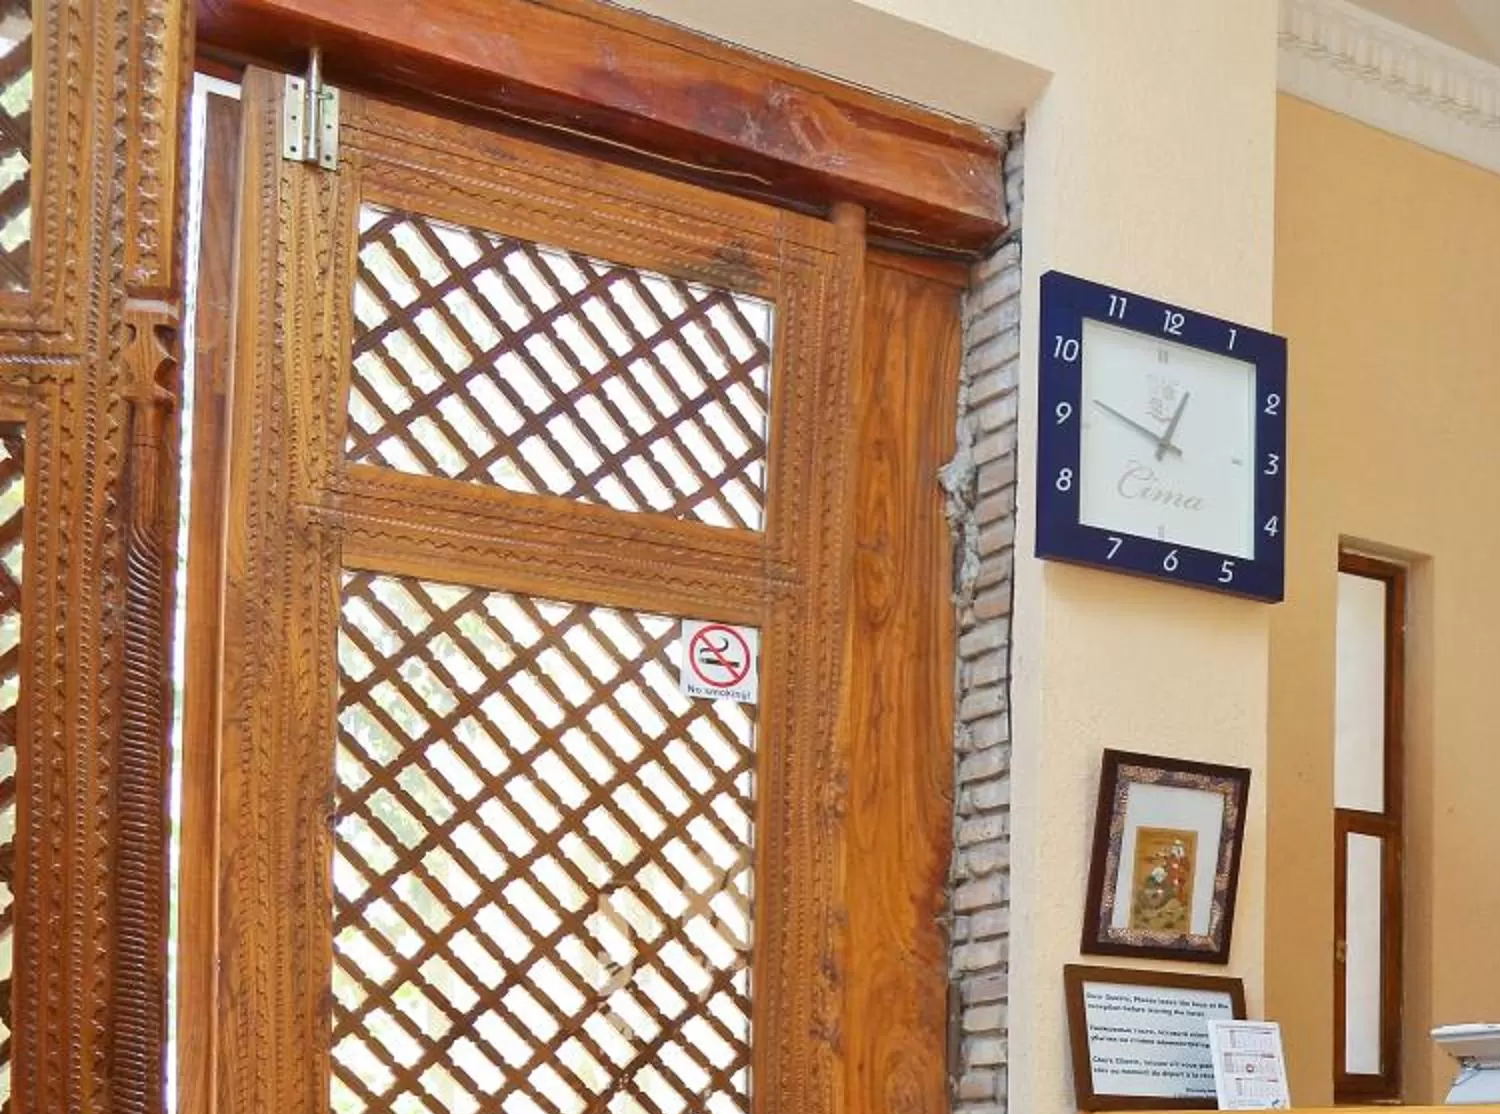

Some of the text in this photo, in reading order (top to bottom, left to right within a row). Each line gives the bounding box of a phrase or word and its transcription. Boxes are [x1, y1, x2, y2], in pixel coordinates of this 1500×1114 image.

[1108, 295, 1127, 319] 11
[1163, 310, 1185, 335] 12
[1053, 335, 1079, 362] 10
[1227, 329, 1238, 350] 1
[1056, 402, 1072, 424] 9
[1264, 394, 1280, 415] 2
[1264, 453, 1279, 475] 3
[1056, 468, 1072, 491] 8
[1263, 515, 1279, 537] 4
[1106, 537, 1123, 560] 7
[1163, 550, 1178, 572] 6
[1218, 560, 1235, 583] 5
[687, 684, 702, 694] No
